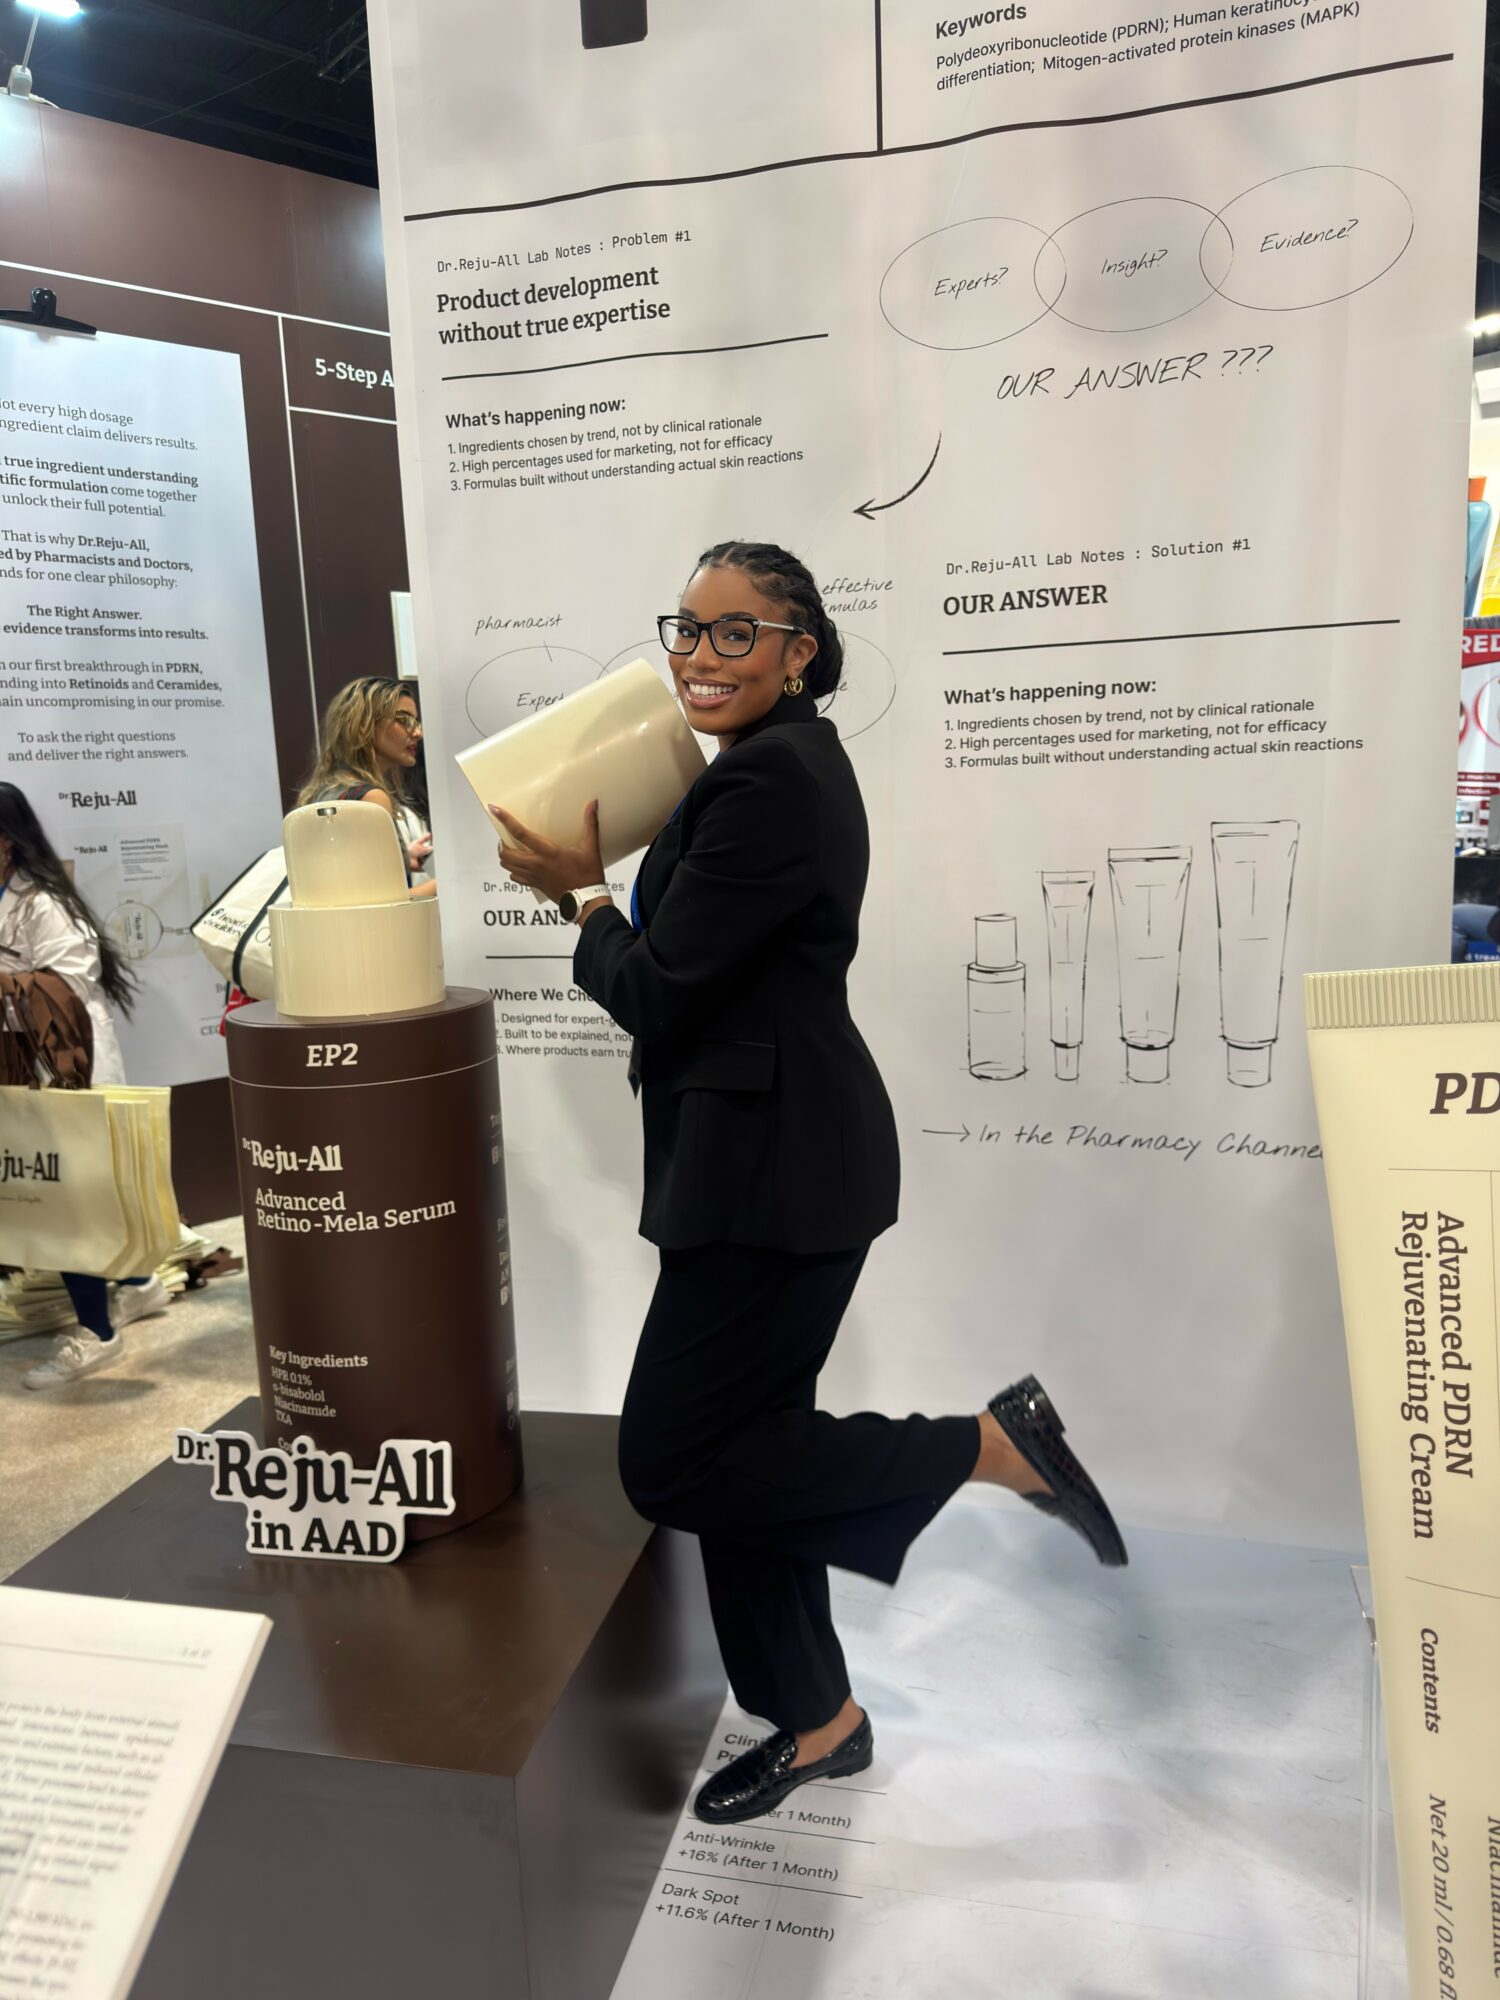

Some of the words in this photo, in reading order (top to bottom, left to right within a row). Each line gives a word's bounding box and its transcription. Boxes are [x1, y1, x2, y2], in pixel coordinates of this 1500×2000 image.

[936, 3, 1026, 39] Keywords
[936, 30, 1107, 69] Polydeoxyribonucleotide
[1112, 17, 1168, 42] (PDRN);
[1173, 9, 1226, 28] Human
[936, 59, 1034, 90] differentiation;
[1043, 37, 1175, 70] Mitogen-activated
[1180, 28, 1232, 52] protein
[1237, 18, 1295, 39] kinases
[1300, 0, 1359, 29] (MAPK)
[437, 253, 519, 272] Dr.Reju-All
[527, 250, 548, 263] Lab
[555, 244, 591, 258] Notes
[612, 232, 667, 248] Problem
[674, 230, 691, 242] #1
[1259, 219, 1360, 254] Evidence?
[1101, 249, 1168, 277] Insight?
[436, 288, 520, 312] Product
[524, 266, 659, 304] development
[934, 267, 1009, 300] Experts?
[438, 320, 522, 344] without
[525, 317, 568, 336] true
[572, 298, 670, 332] expertise
[315, 358, 378, 390] 5-Step
[997, 368, 1055, 400] OUR
[1064, 352, 1208, 400] ANSWER
[18, 402, 55, 418] every
[57, 404, 86, 421] high
[89, 408, 133, 427] dosage
[504, 403, 585, 426] happening
[589, 399, 625, 414] now:
[66, 424, 101, 439] claim
[104, 428, 152, 444] delivers
[155, 437, 197, 450] results.
[458, 439, 524, 455] Ingredients
[527, 435, 567, 448] chosen
[586, 426, 618, 441] trend,
[662, 419, 705, 433] clinical
[708, 415, 761, 430] rationale
[492, 455, 563, 472] percentages
[613, 441, 676, 457] marketing,
[724, 435, 772, 448] efficacy
[4, 455, 33, 468] true
[36, 457, 105, 475] ingredient
[107, 466, 198, 488] understanding
[463, 476, 516, 490] Formulas
[591, 460, 674, 479] understanding
[747, 450, 803, 465] reactions
[1, 492, 48, 506] unlock
[50, 495, 82, 509] their
[84, 498, 105, 511] full
[108, 503, 165, 516] potential.
[28, 475, 108, 494] formulation
[110, 486, 144, 497] come
[146, 488, 196, 502] together
[1, 529, 32, 542] That
[77, 535, 149, 552] Dr.Reju-All,
[946, 554, 1037, 574] Dr.Reju-All
[1047, 552, 1072, 565] Lab
[1081, 550, 1124, 563] Notes
[1151, 541, 1222, 557] Solution
[1232, 538, 1250, 550] #1
[34, 550, 115, 566] Pharmacists
[143, 557, 192, 572] Doctors,
[74, 570, 106, 583] clear
[108, 572, 177, 589] philosophy:
[822, 577, 894, 595] effective
[54, 605, 89, 620] Right
[92, 607, 142, 619] Answer.
[943, 593, 994, 615] OUR
[999, 584, 1107, 611] ANSWER
[3, 622, 62, 635] evidence
[64, 624, 136, 637] transforms
[164, 628, 208, 639] results.
[475, 614, 563, 636] pharmacist
[63, 659, 149, 675] breakthrough
[68, 677, 129, 689] Retinoids
[156, 679, 222, 691] Ceramides,
[1010, 681, 1105, 703] happening
[1111, 681, 1155, 694] now:
[25, 695, 135, 710] uncompromising
[174, 696, 224, 710] promise.
[957, 716, 1029, 732] Ingredients
[1032, 714, 1081, 726] chosen
[1106, 708, 1145, 723] trend,
[1198, 702, 1246, 716] clinical
[1251, 698, 1314, 713] rationale
[117, 730, 176, 744] questions
[993, 734, 1075, 750] percentages
[1138, 724, 1212, 739] marketing,
[1267, 719, 1326, 733] efficacy
[1108, 744, 1209, 760] understanding
[1294, 737, 1363, 751] reactions
[35, 749, 80, 760] deliver
[137, 749, 188, 758] answers.
[483, 910, 526, 926] OUR
[490, 989, 537, 1001] Where
[541, 989, 564, 1001] We
[501, 1013, 552, 1024] Designed
[505, 1029, 528, 1039] Built
[560, 1030, 613, 1044] explained,
[506, 1045, 541, 1055] Where
[543, 1045, 589, 1057] products
[591, 1048, 615, 1058] earn
[306, 1043, 360, 1068] EP2
[979, 1125, 1002, 1144] In
[1015, 1124, 1053, 1145] the
[1066, 1125, 1203, 1161] Pharmacy
[0, 1149, 61, 1183] ju-All
[255, 1188, 346, 1212] Advanced
[257, 1208, 380, 1233] Retino-Mela
[384, 1200, 457, 1228] Serum
[1437, 1211, 1473, 1372] Advanced
[1395, 1210, 1437, 1424] Rejuvenating
[288, 1351, 369, 1370] Ingredients
[1442, 1383, 1474, 1479] PDRN
[215, 1438, 449, 1513] Reju-All
[1409, 1433, 1436, 1540] Cream
[250, 1510, 294, 1551] in
[301, 1518, 398, 1557] AAD
[1420, 1627, 1440, 1734] Contents
[798, 1812, 852, 1830] Month)
[1429, 1793, 1447, 1839] Net
[683, 1830, 776, 1853] Anti-Wrinkle
[678, 1849, 718, 1864] +16%
[723, 1854, 768, 1871] (After
[783, 1863, 839, 1882] Month)
[661, 1883, 700, 1900] Dark
[702, 1889, 740, 1906] Spot
[655, 1903, 708, 1922] +11.6%
[713, 1911, 760, 1929] (After
[776, 1921, 835, 1943] Month)
[1436, 1925, 1455, 1980] 0.68
